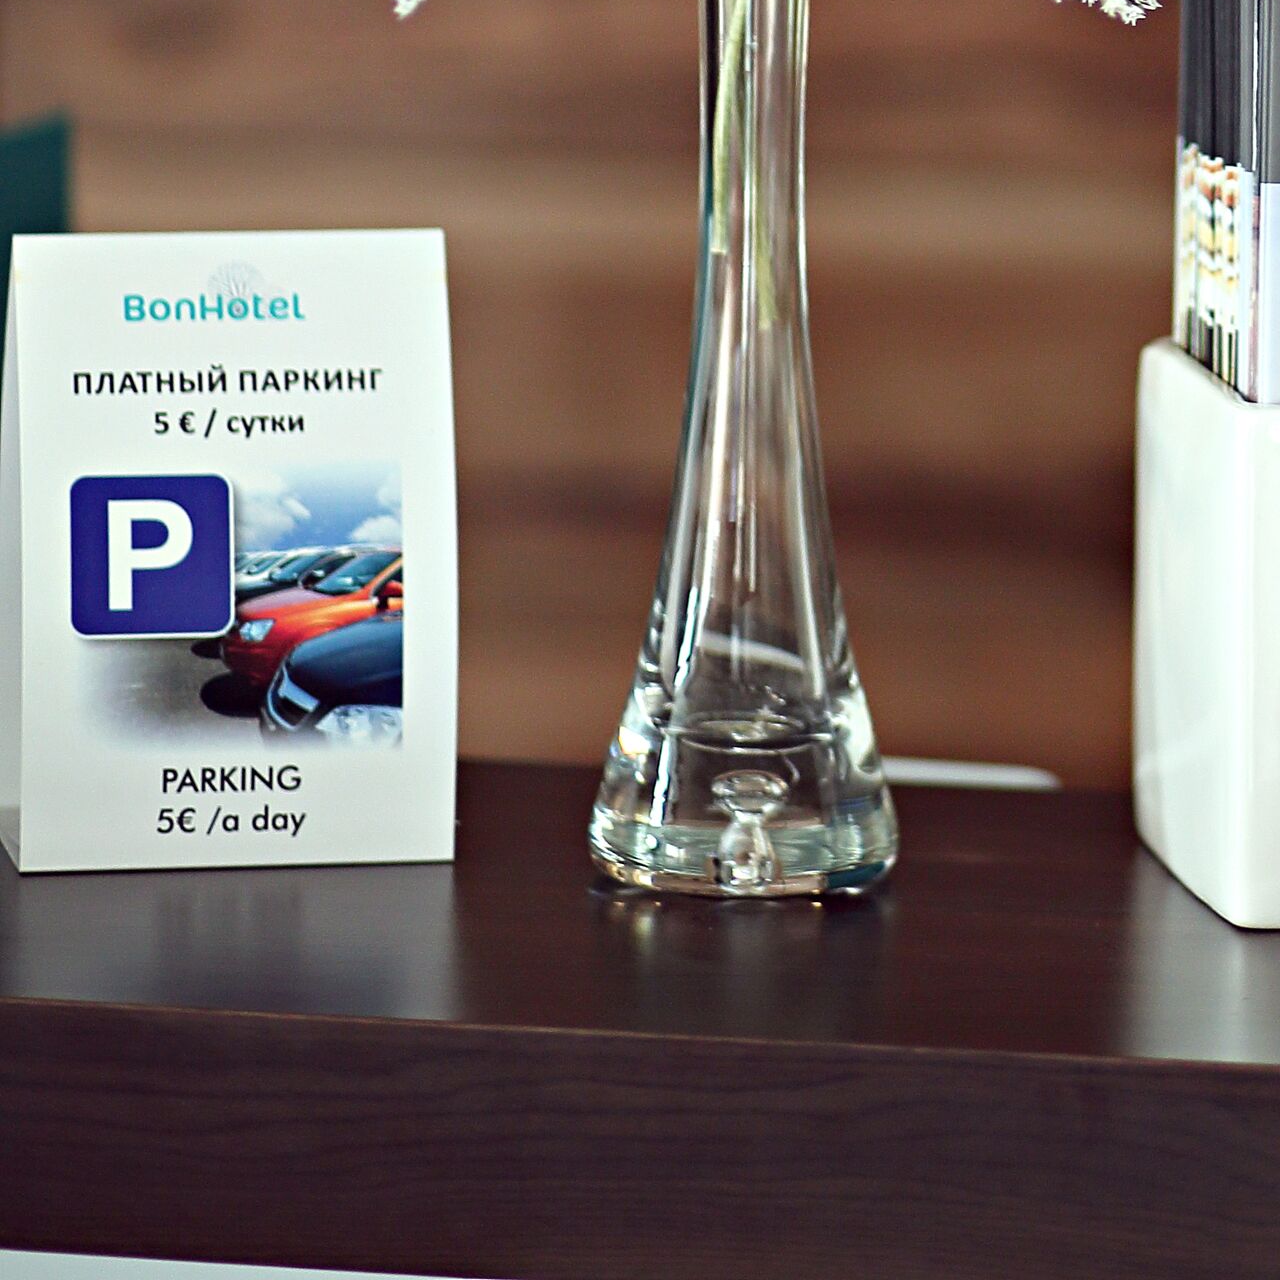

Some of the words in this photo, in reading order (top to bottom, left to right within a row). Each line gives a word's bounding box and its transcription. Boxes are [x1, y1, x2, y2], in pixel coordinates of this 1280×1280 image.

[122, 292, 306, 322] BonHotel
[72, 363, 228, 395] ПЛАТНЫЙ
[239, 369, 382, 392] ПАРКИНГ
[154, 411, 169, 434] 5
[179, 411, 195, 434] €
[203, 408, 217, 438] /
[227, 412, 305, 438] сутки
[107, 499, 194, 611] P
[161, 765, 302, 793] PARKING
[156, 808, 196, 834] 5€
[206, 807, 240, 835] /a
[251, 805, 306, 836] day
